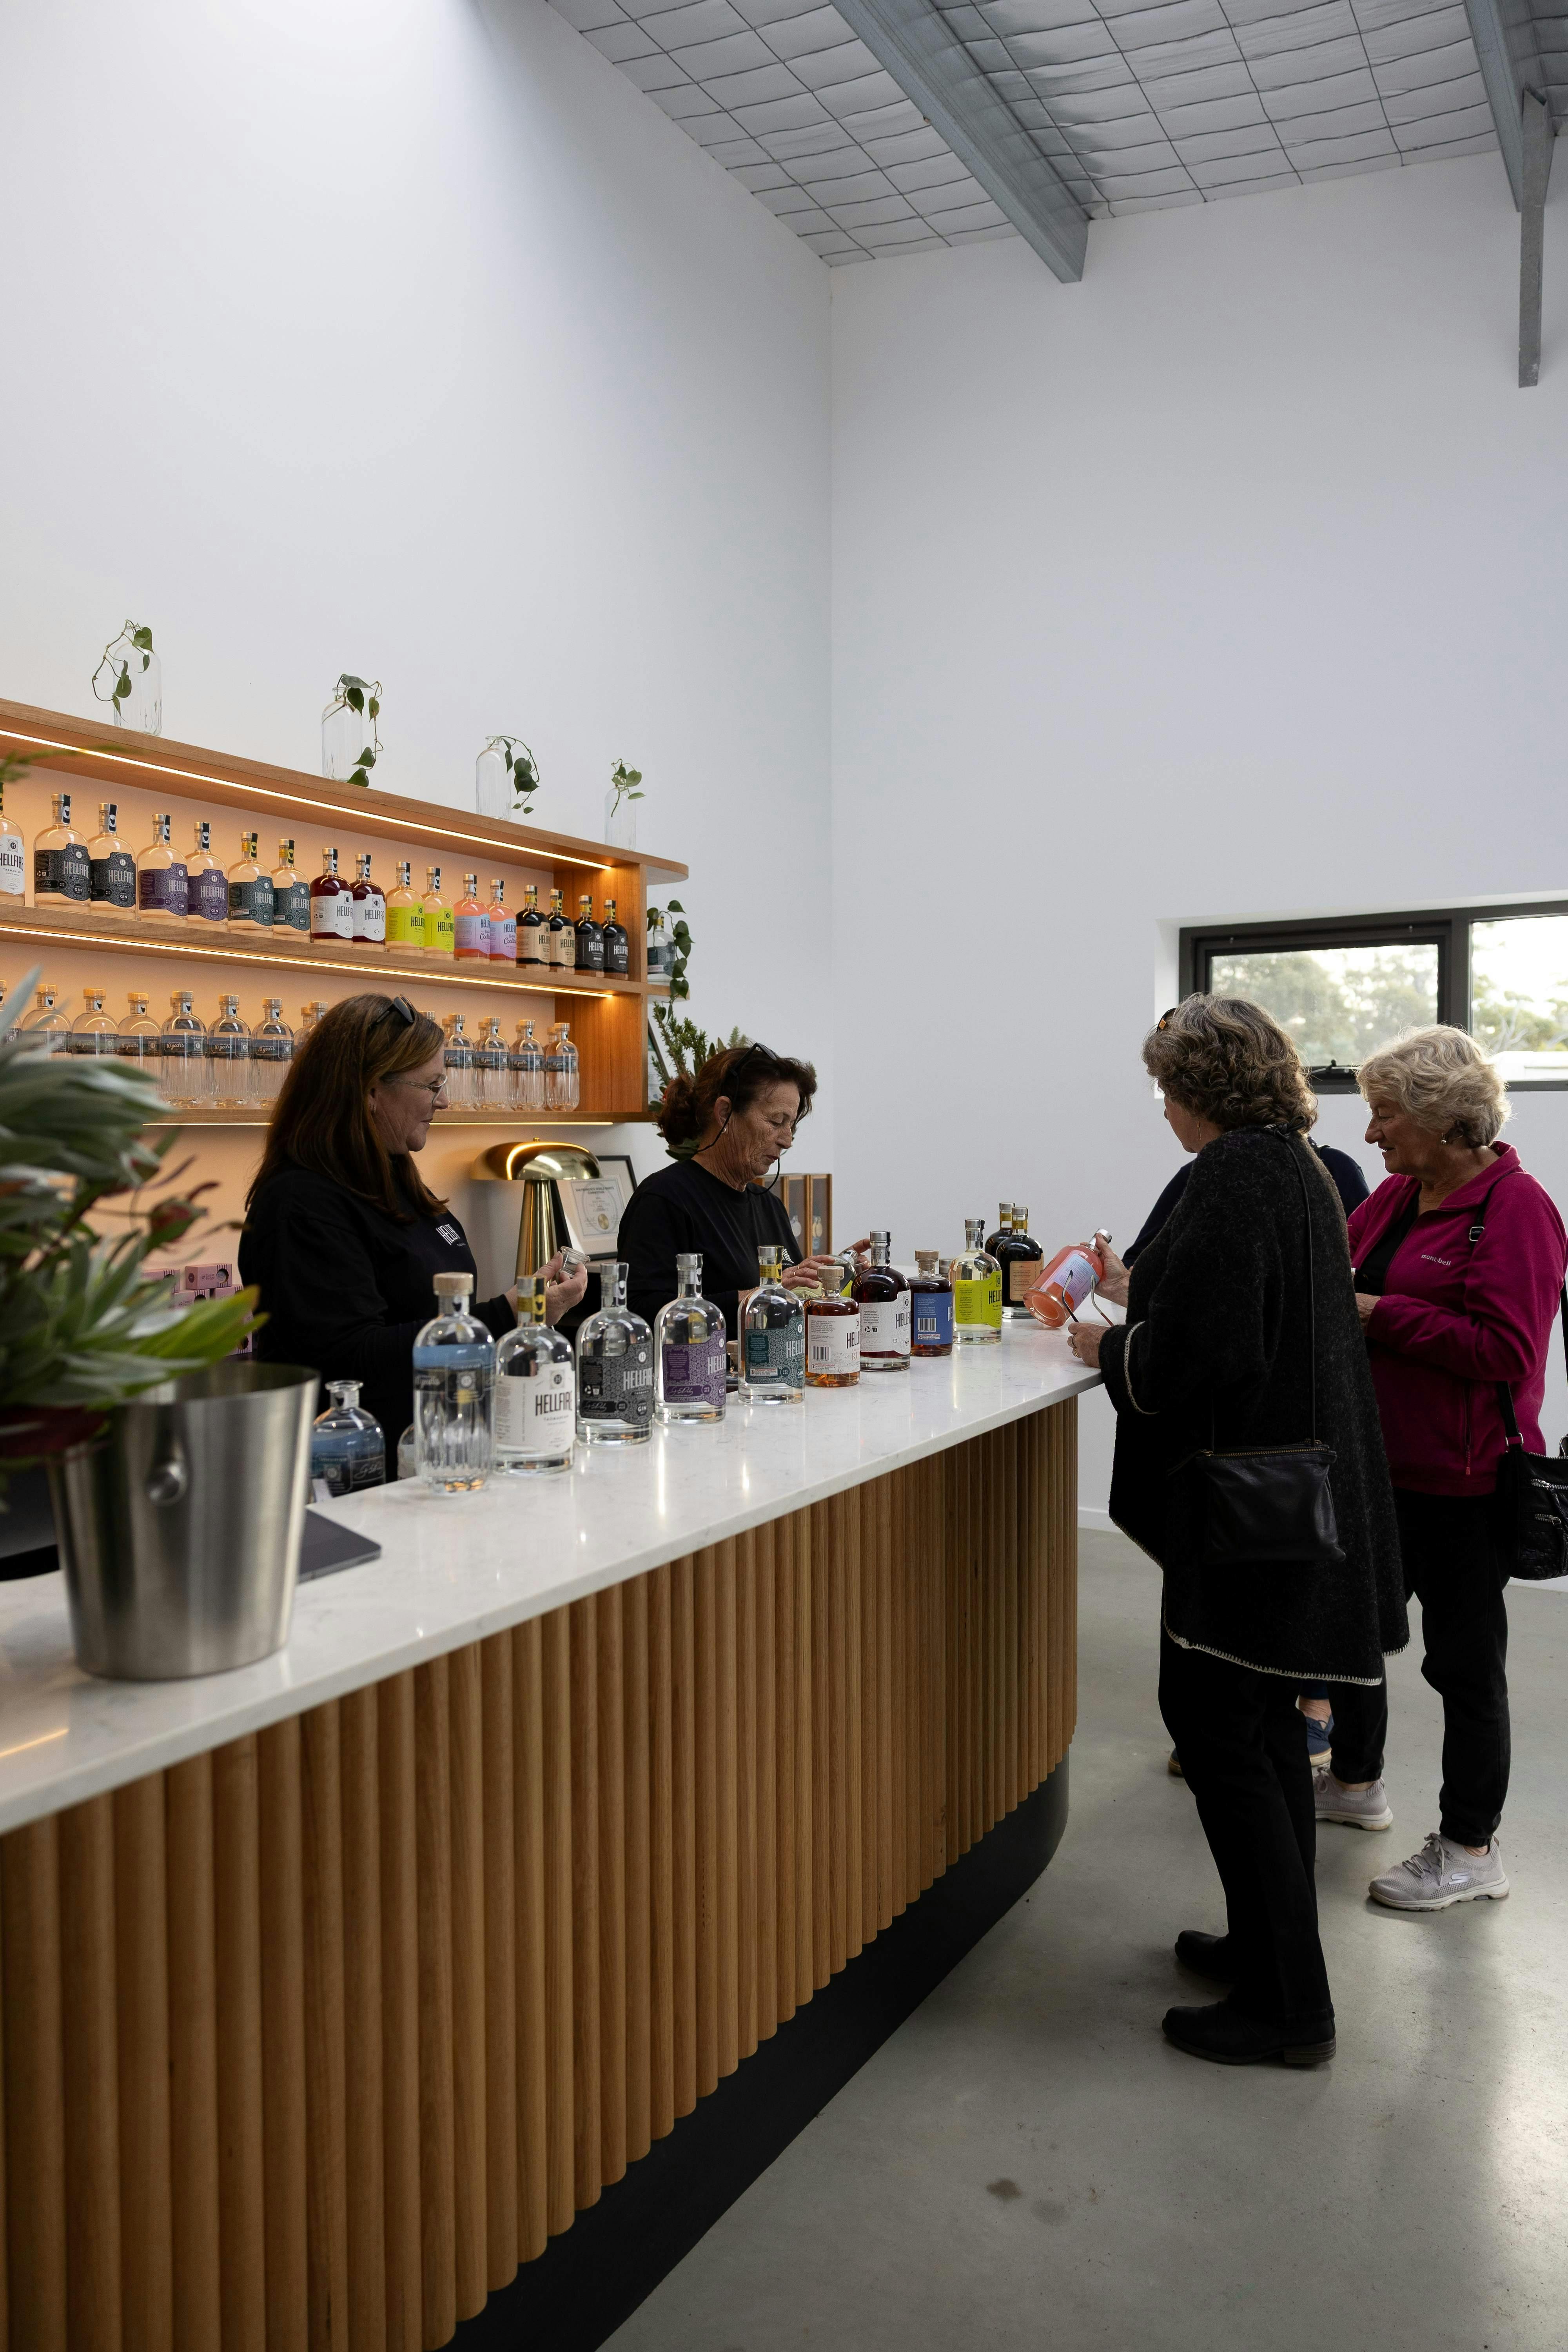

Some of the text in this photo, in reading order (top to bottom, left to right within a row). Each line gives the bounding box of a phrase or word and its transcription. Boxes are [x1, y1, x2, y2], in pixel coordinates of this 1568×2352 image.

[108, 869, 134, 886] HELLFIRE
[201, 886, 225, 900] HELLFIRE
[365, 909, 385, 922] HELLFIRE
